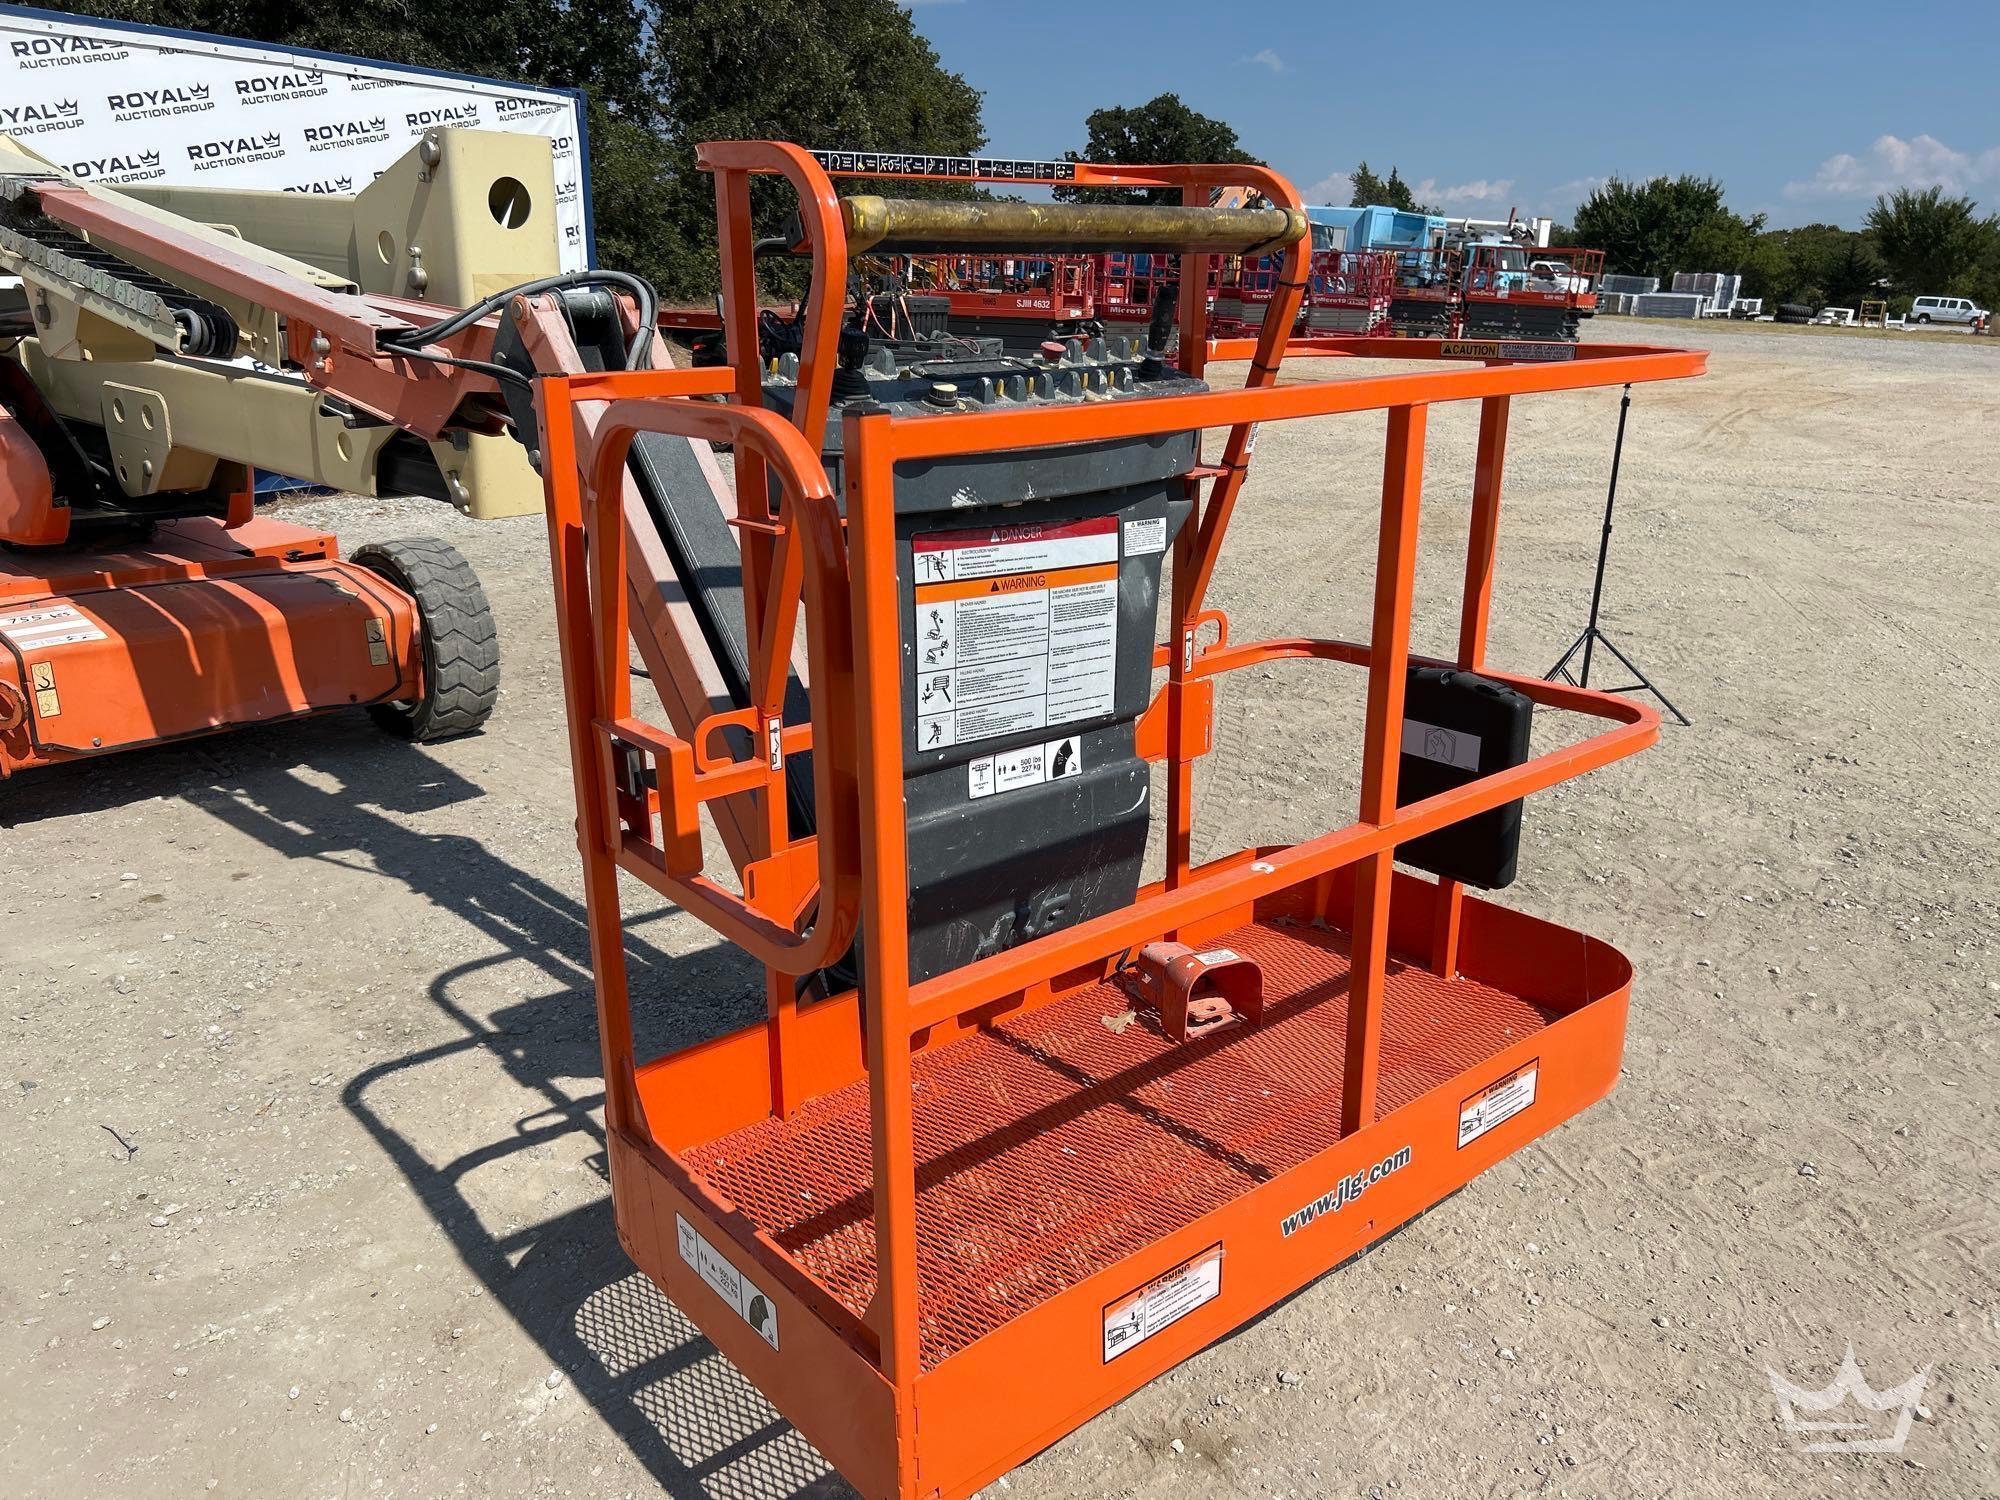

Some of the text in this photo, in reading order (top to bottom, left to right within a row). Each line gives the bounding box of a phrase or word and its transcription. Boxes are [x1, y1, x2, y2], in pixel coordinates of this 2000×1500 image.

[10, 36, 103, 57] ROYAL
[19, 51, 129, 69] AUCTION GROUP
[234, 74, 307, 94] ROYAL
[351, 81, 393, 91] AUCTION
[107, 87, 191, 110] ROYAL
[241, 88, 328, 106] AUCTION GROUP
[0, 104, 58, 125] YAL
[114, 102, 215, 122] AUCTION GROUP
[406, 107, 464, 126] ROYAL
[499, 106, 562, 122] AUCTION GROUP
[36, 119, 84, 133] GROUP
[304, 121, 371, 141] ROYAL
[451, 119, 481, 129] GROUP
[186, 136, 264, 160] ROYAL
[309, 133, 390, 152] AUCTION GROUP
[193, 150, 286, 171] AUCTION GROUP
[122, 169, 166, 184] GROUP
[1032, 300, 1051, 308] 4632
[1109, 306, 1147, 315] Micro19
[1452, 344, 1496, 355] CAUTION
[1136, 519, 1160, 527] WARNING
[1001, 527, 1043, 541] DANGER
[1000, 576, 1046, 591] WARNING
[1020, 759, 1031, 767] 500
[1021, 763, 1041, 773] 227 kg
[1488, 1073, 1518, 1094] WARNING
[1281, 1146, 1411, 1237] www.jlg.com
